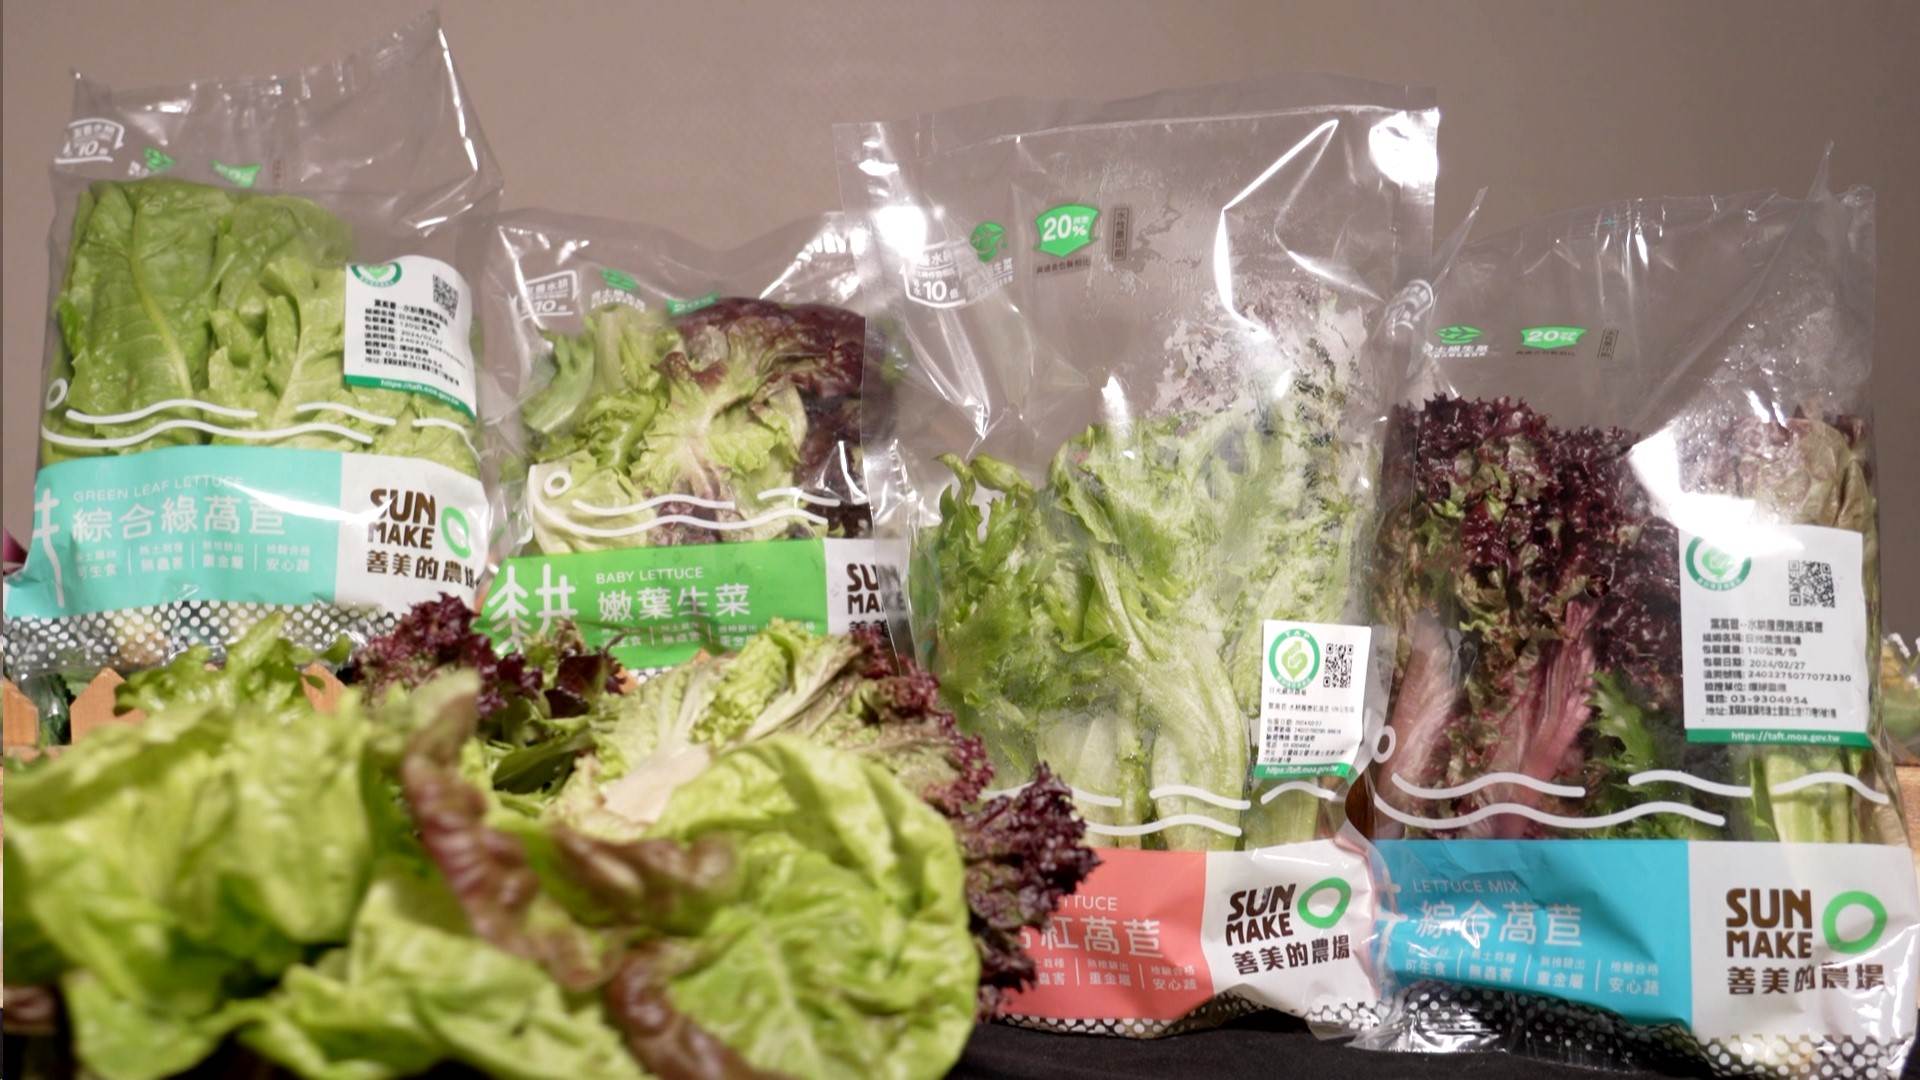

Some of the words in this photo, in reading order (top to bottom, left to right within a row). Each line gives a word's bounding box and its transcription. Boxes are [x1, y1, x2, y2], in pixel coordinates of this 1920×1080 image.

[73, 487, 128, 502] GREEN
[134, 480, 169, 497] LEAF
[174, 473, 245, 490] LETTUCE
[72, 493, 286, 544] 綜合綠萵苣
[370, 488, 436, 526] SUN
[367, 522, 435, 550] MAKE
[596, 571, 634, 585] BABY
[639, 566, 704, 581] LETTUCE
[597, 582, 750, 622] 嫩葉生菜
[1731, 730, 1841, 743] https://taft.moa.gov.tw
[1227, 883, 1297, 922] SUN
[1412, 879, 1484, 894] LETTUCE
[1488, 880, 1520, 894] MIX
[1414, 900, 1583, 947] 綜合萵苣
[1725, 887, 1813, 929] SUN
[1225, 912, 1294, 947] MAKE
[1726, 930, 1813, 959] MAKE
[1232, 934, 1350, 976] 善美的農場
[1727, 961, 1885, 996] 善美的農場
